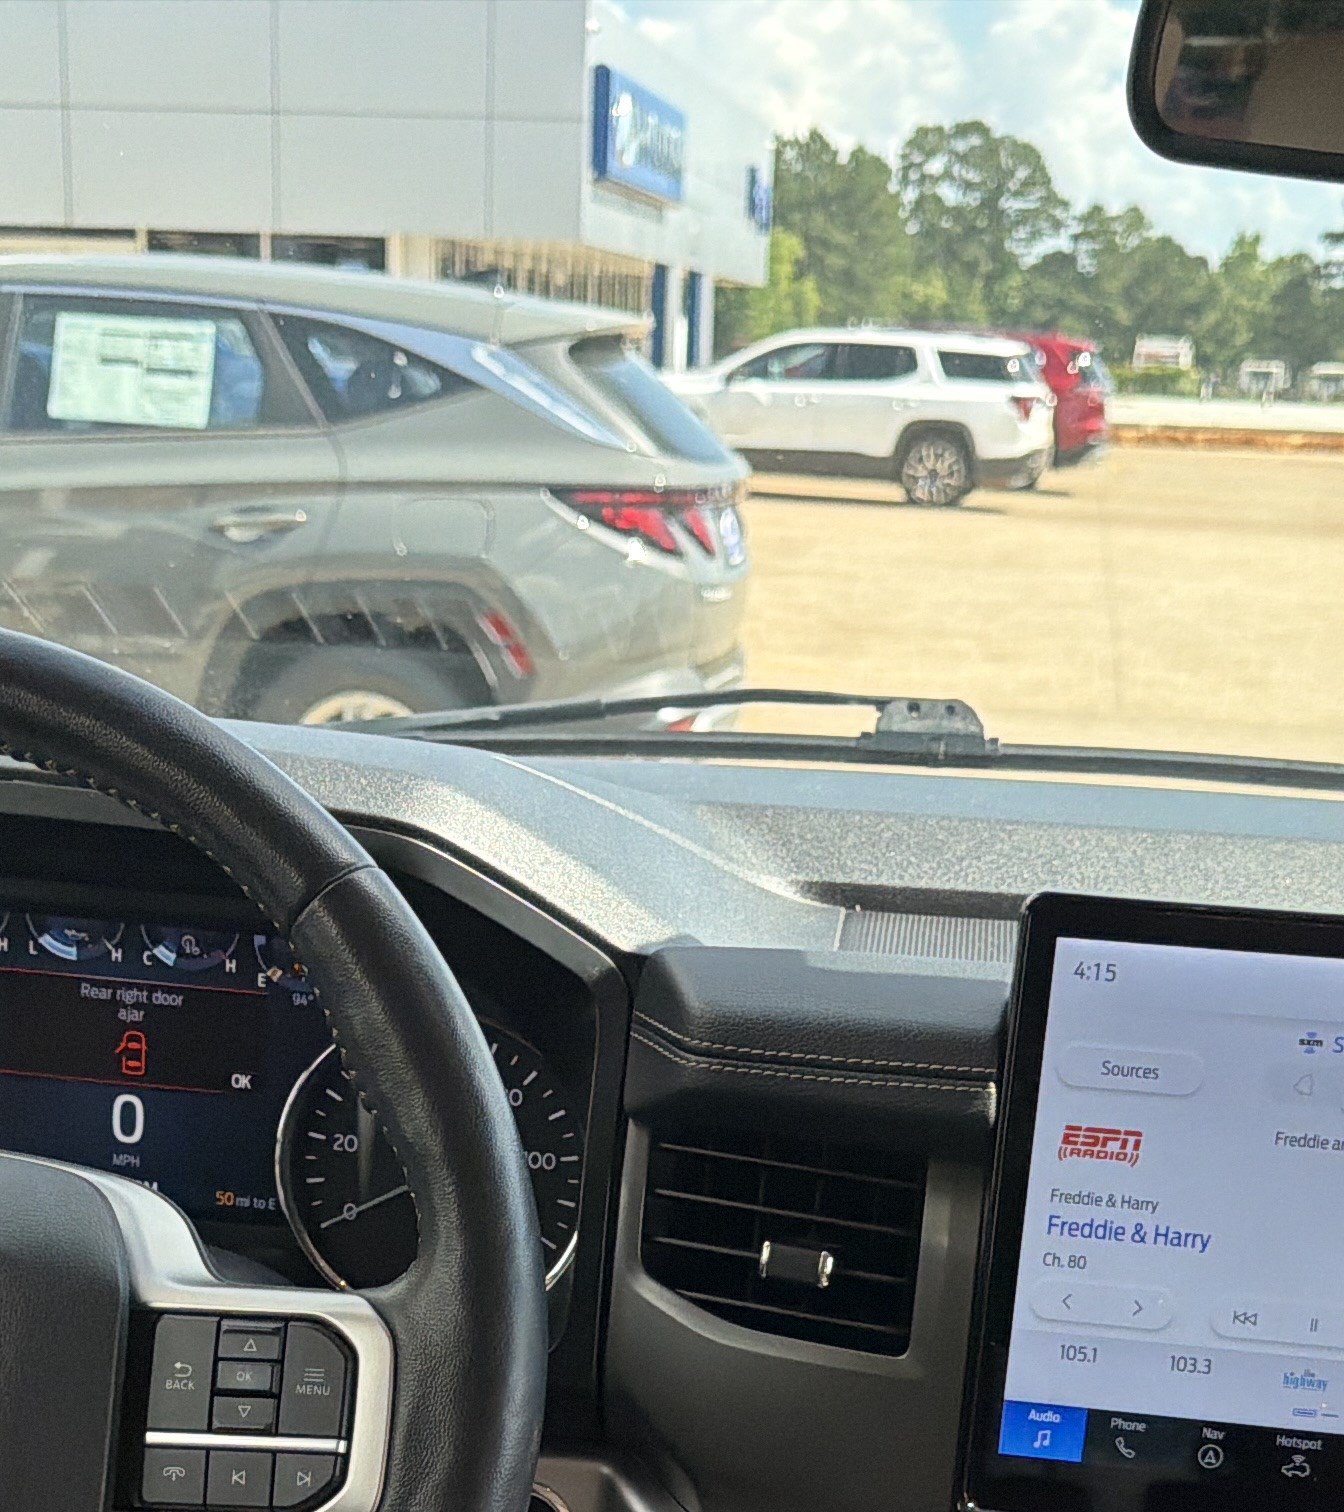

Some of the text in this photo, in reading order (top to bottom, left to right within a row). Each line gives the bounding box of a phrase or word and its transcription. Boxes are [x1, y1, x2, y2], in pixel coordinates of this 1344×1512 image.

[28, 940, 38, 955] L
[111, 948, 123, 963] H
[142, 950, 153, 966] C
[225, 958, 236, 974] H
[257, 972, 267, 988] E
[1073, 961, 1117, 982] 4:15
[80, 983, 184, 1008] Rear right door
[117, 1006, 145, 1023] ajar
[1100, 1059, 1160, 1081] Sources
[230, 1073, 252, 1090] OK
[112, 1093, 144, 1144] 0
[333, 1133, 358, 1152] 20
[1061, 1124, 1144, 1152] ESPN
[1274, 1130, 1330, 1150] Freddie
[112, 1153, 141, 1168] MPH
[215, 1190, 277, 1211] 50 mi to E
[1050, 1187, 1160, 1215] Freddie & Harry
[1047, 1214, 1212, 1254] Freddie & Harry
[1042, 1251, 1087, 1270] Ch. 80
[1060, 1343, 1098, 1364] 105.1
[1170, 1354, 1212, 1375] 103.3
[165, 1378, 196, 1391] BACK
[236, 1370, 253, 1382] OK
[1282, 1371, 1328, 1392] highway
[294, 1383, 331, 1397] MENU
[1027, 1408, 1061, 1424] Audio
[1110, 1416, 1148, 1433] Phone
[1202, 1426, 1226, 1441] Nav
[1275, 1434, 1323, 1452] Hotspot
